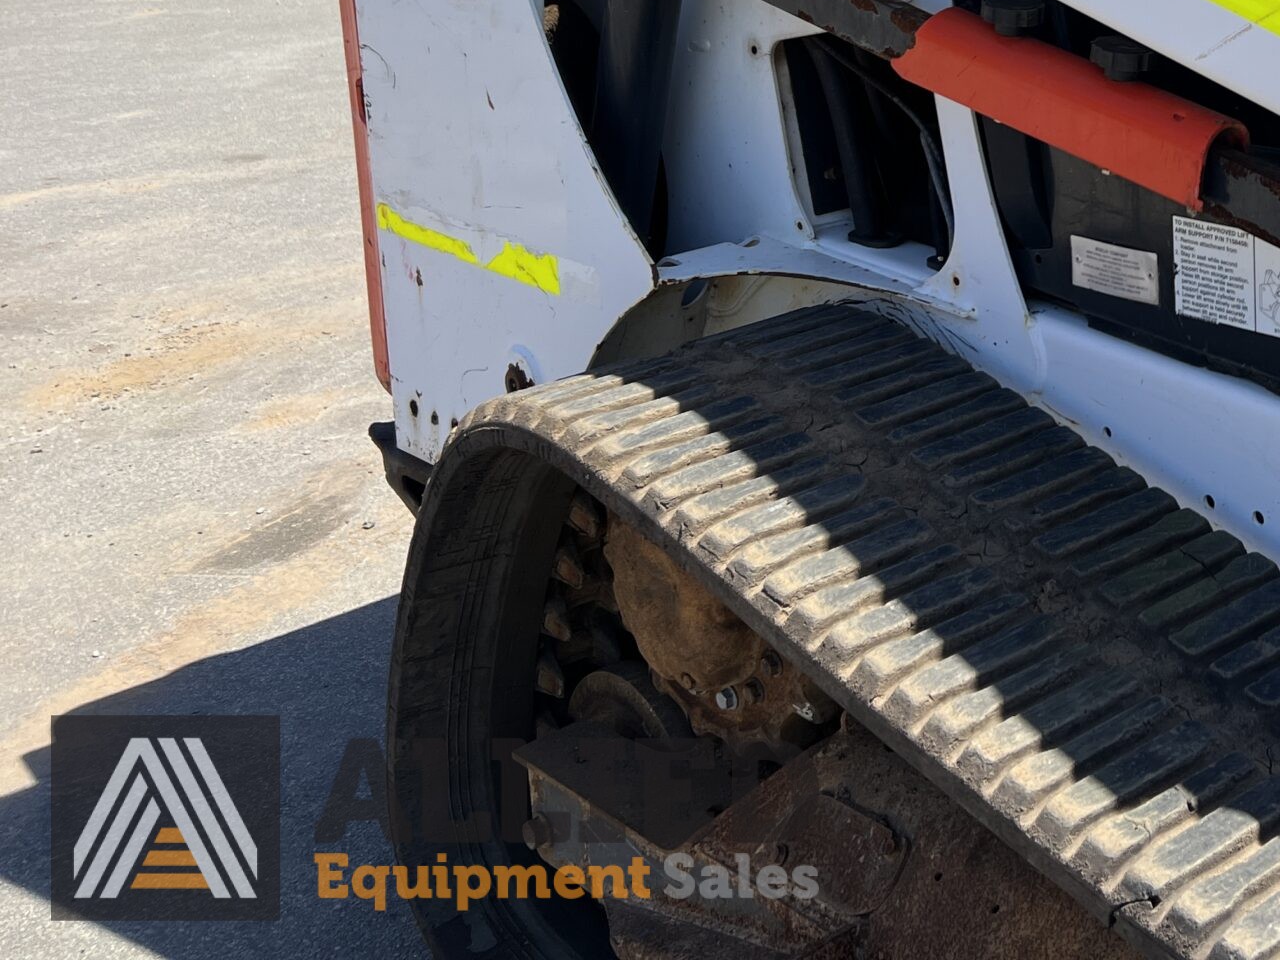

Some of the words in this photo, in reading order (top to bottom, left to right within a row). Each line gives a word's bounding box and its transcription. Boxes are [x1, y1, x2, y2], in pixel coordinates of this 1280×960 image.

[1183, 221, 1204, 230] INSTALL
[1207, 225, 1236, 237] APPROVED
[1238, 231, 1248, 239] LIFT
[1188, 230, 1213, 240] SUPPORT
[1200, 241, 1225, 251] attachment
